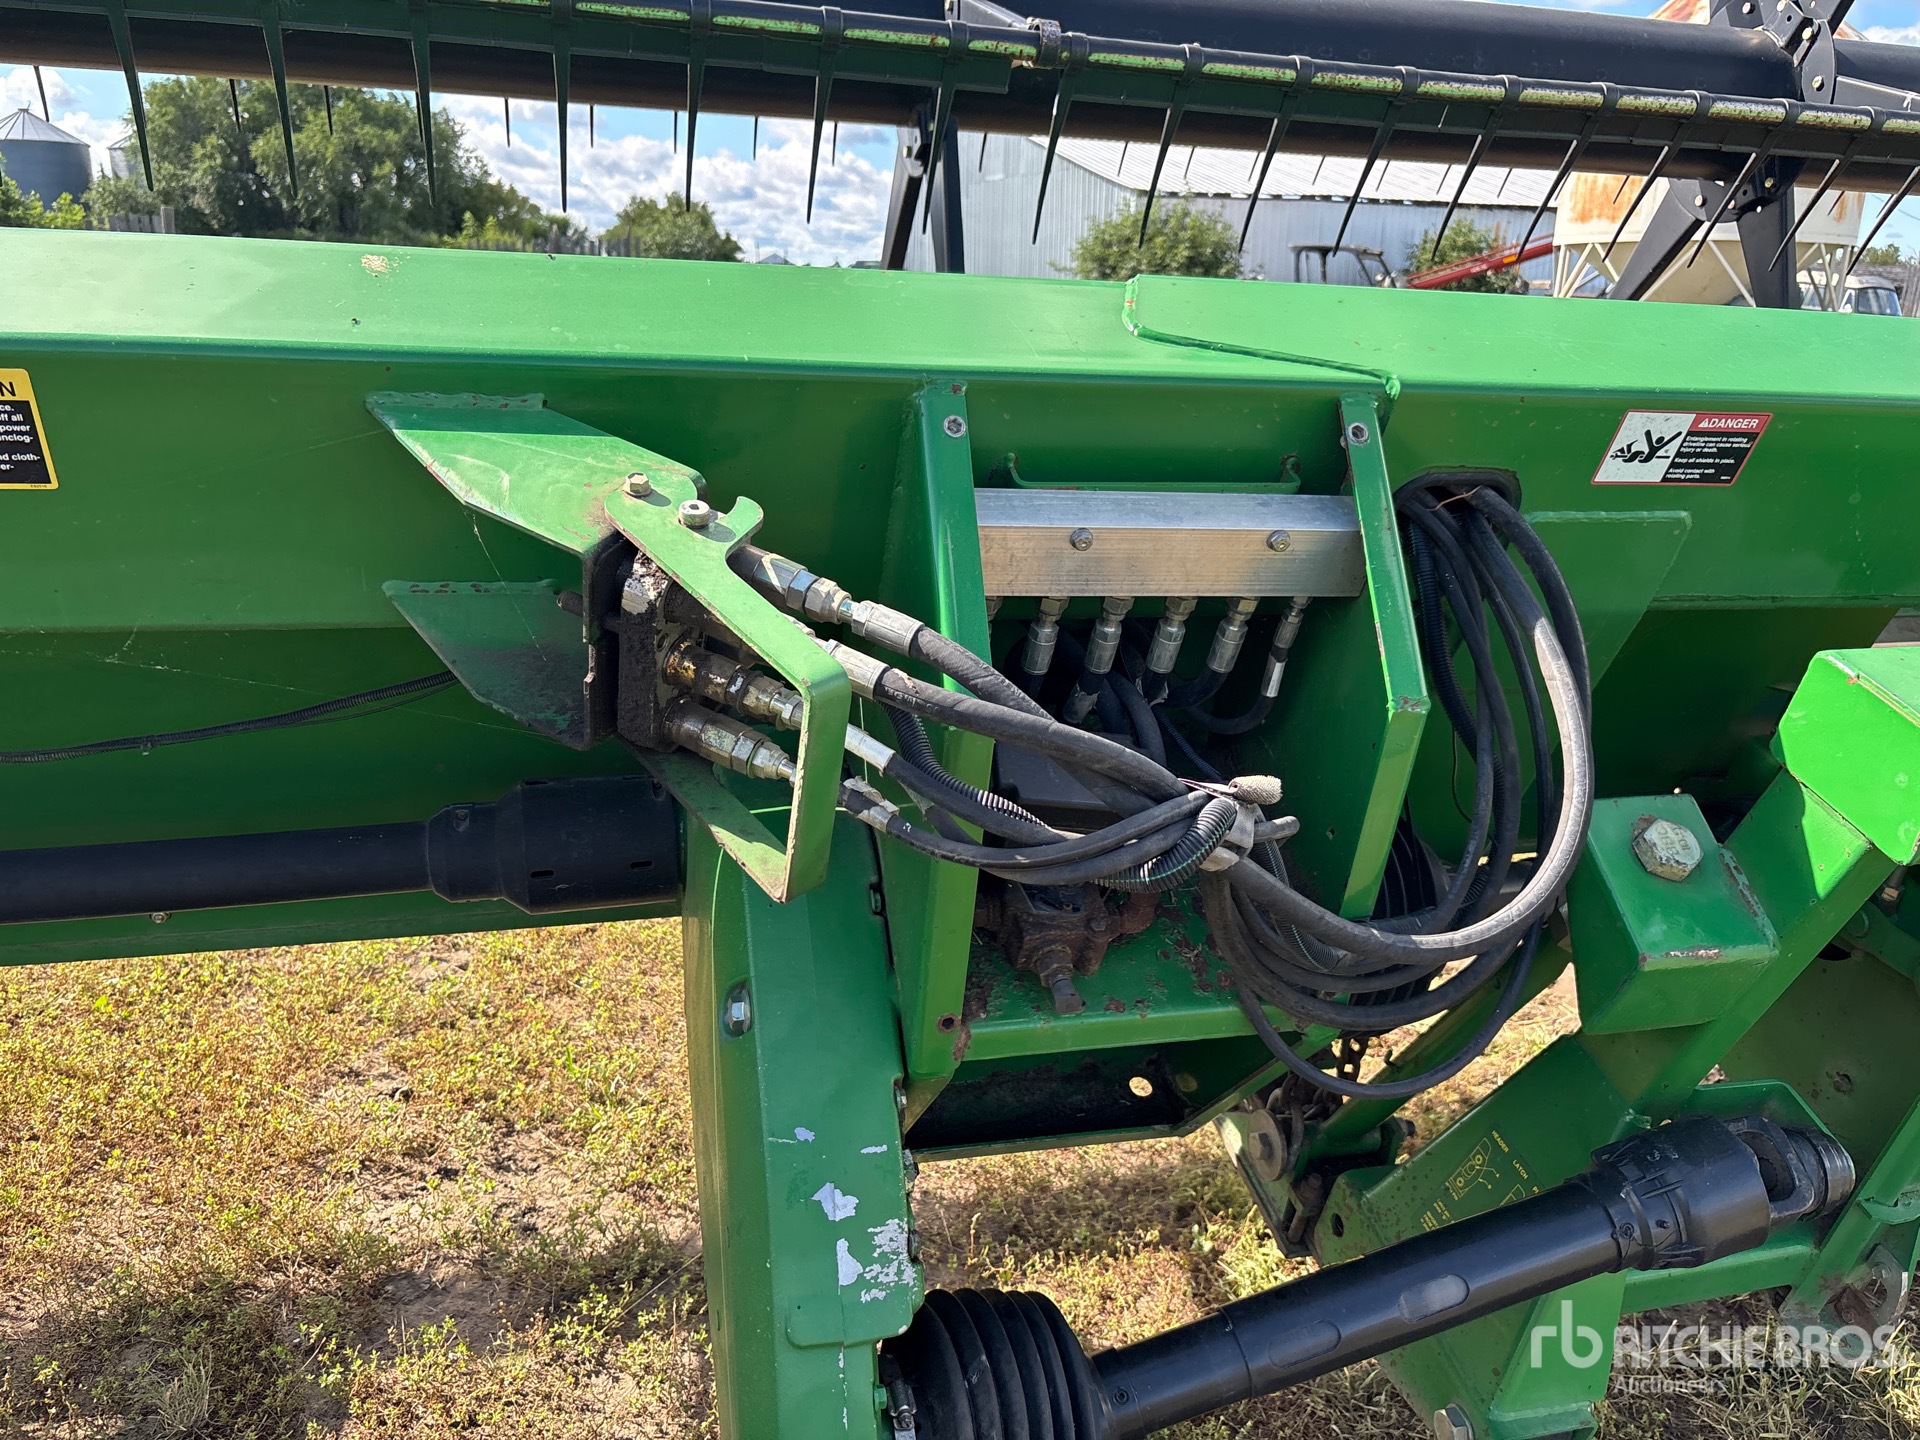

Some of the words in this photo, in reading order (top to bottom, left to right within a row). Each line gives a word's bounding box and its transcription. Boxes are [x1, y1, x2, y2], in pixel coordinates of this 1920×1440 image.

[1708, 418, 1759, 428] DANGER
[0, 425, 30, 433] power
[1491, 1130, 1510, 1153] HEADER
[1512, 1159, 1529, 1180] LATCH
